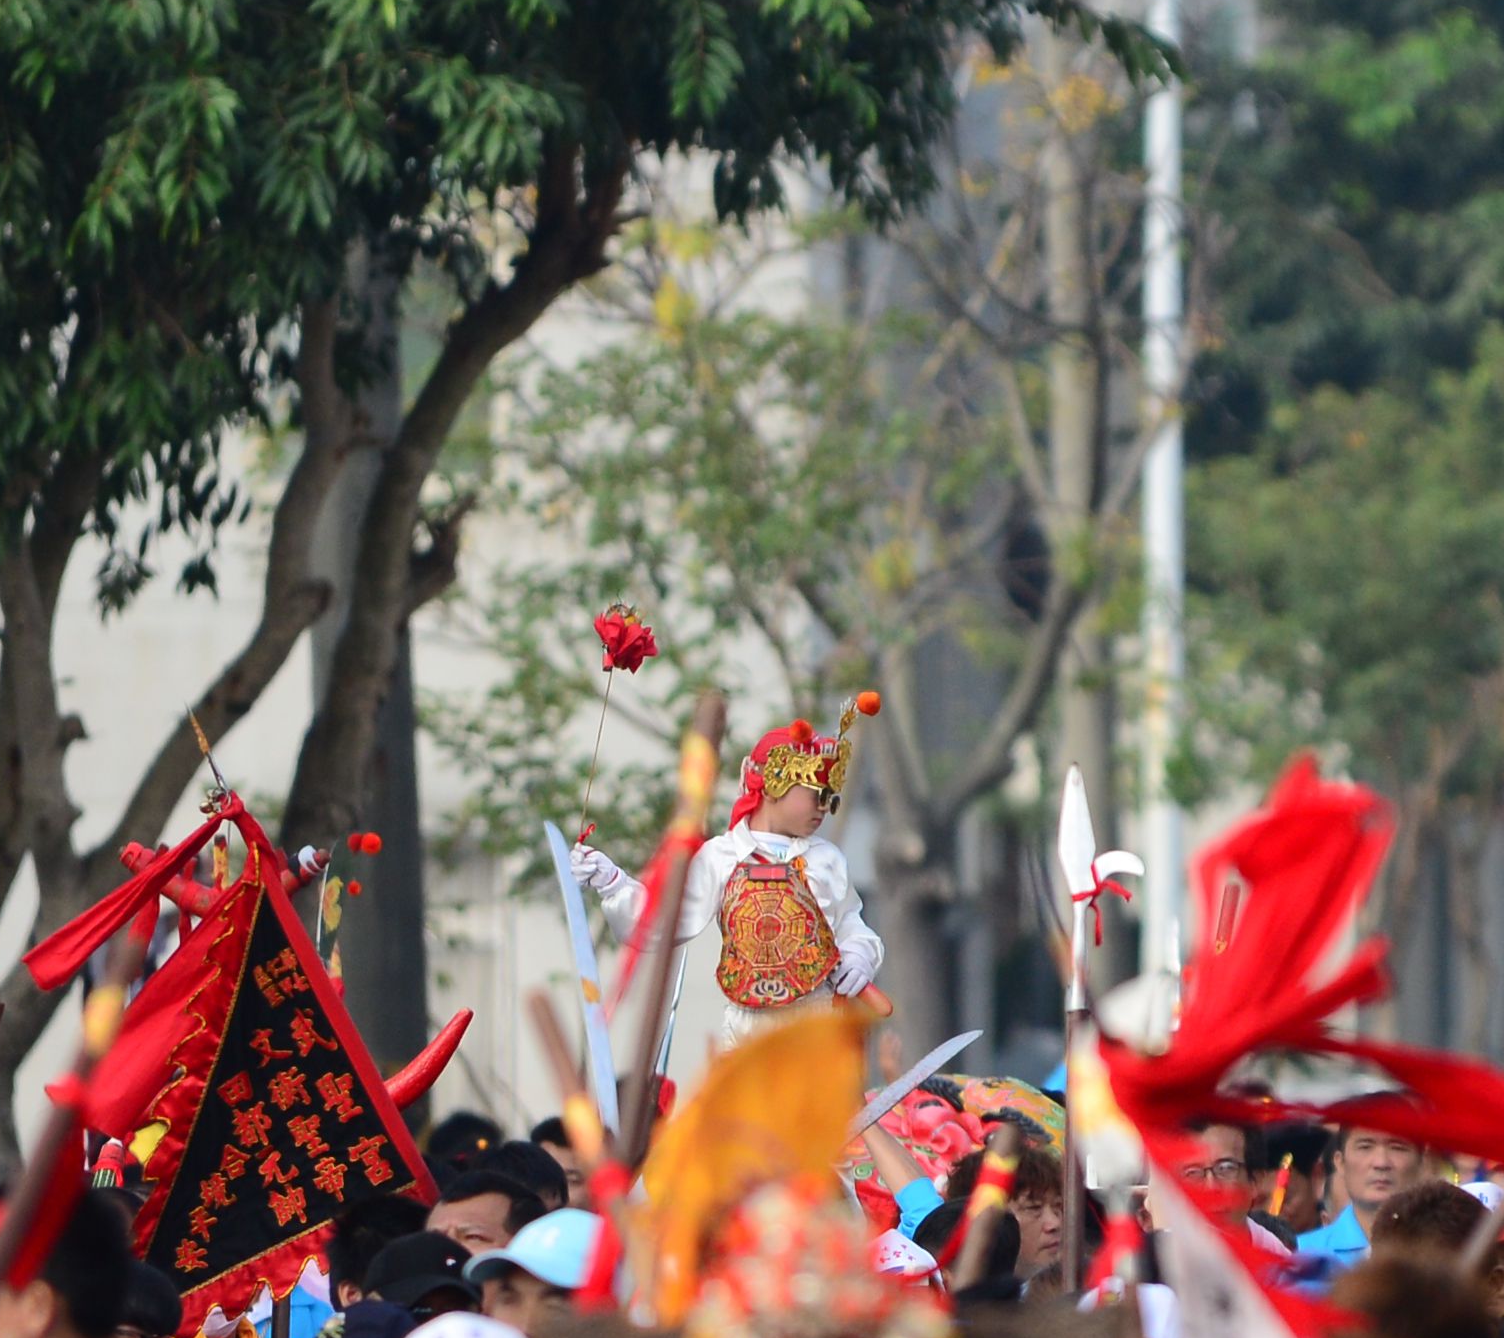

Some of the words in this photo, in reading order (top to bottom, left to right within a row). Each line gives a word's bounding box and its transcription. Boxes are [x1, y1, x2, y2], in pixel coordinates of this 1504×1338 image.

[217, 1070, 307, 1226] 田都元帥
[290, 1008, 394, 1186] 武聖宮
[174, 1143, 251, 1273] 合境平安
